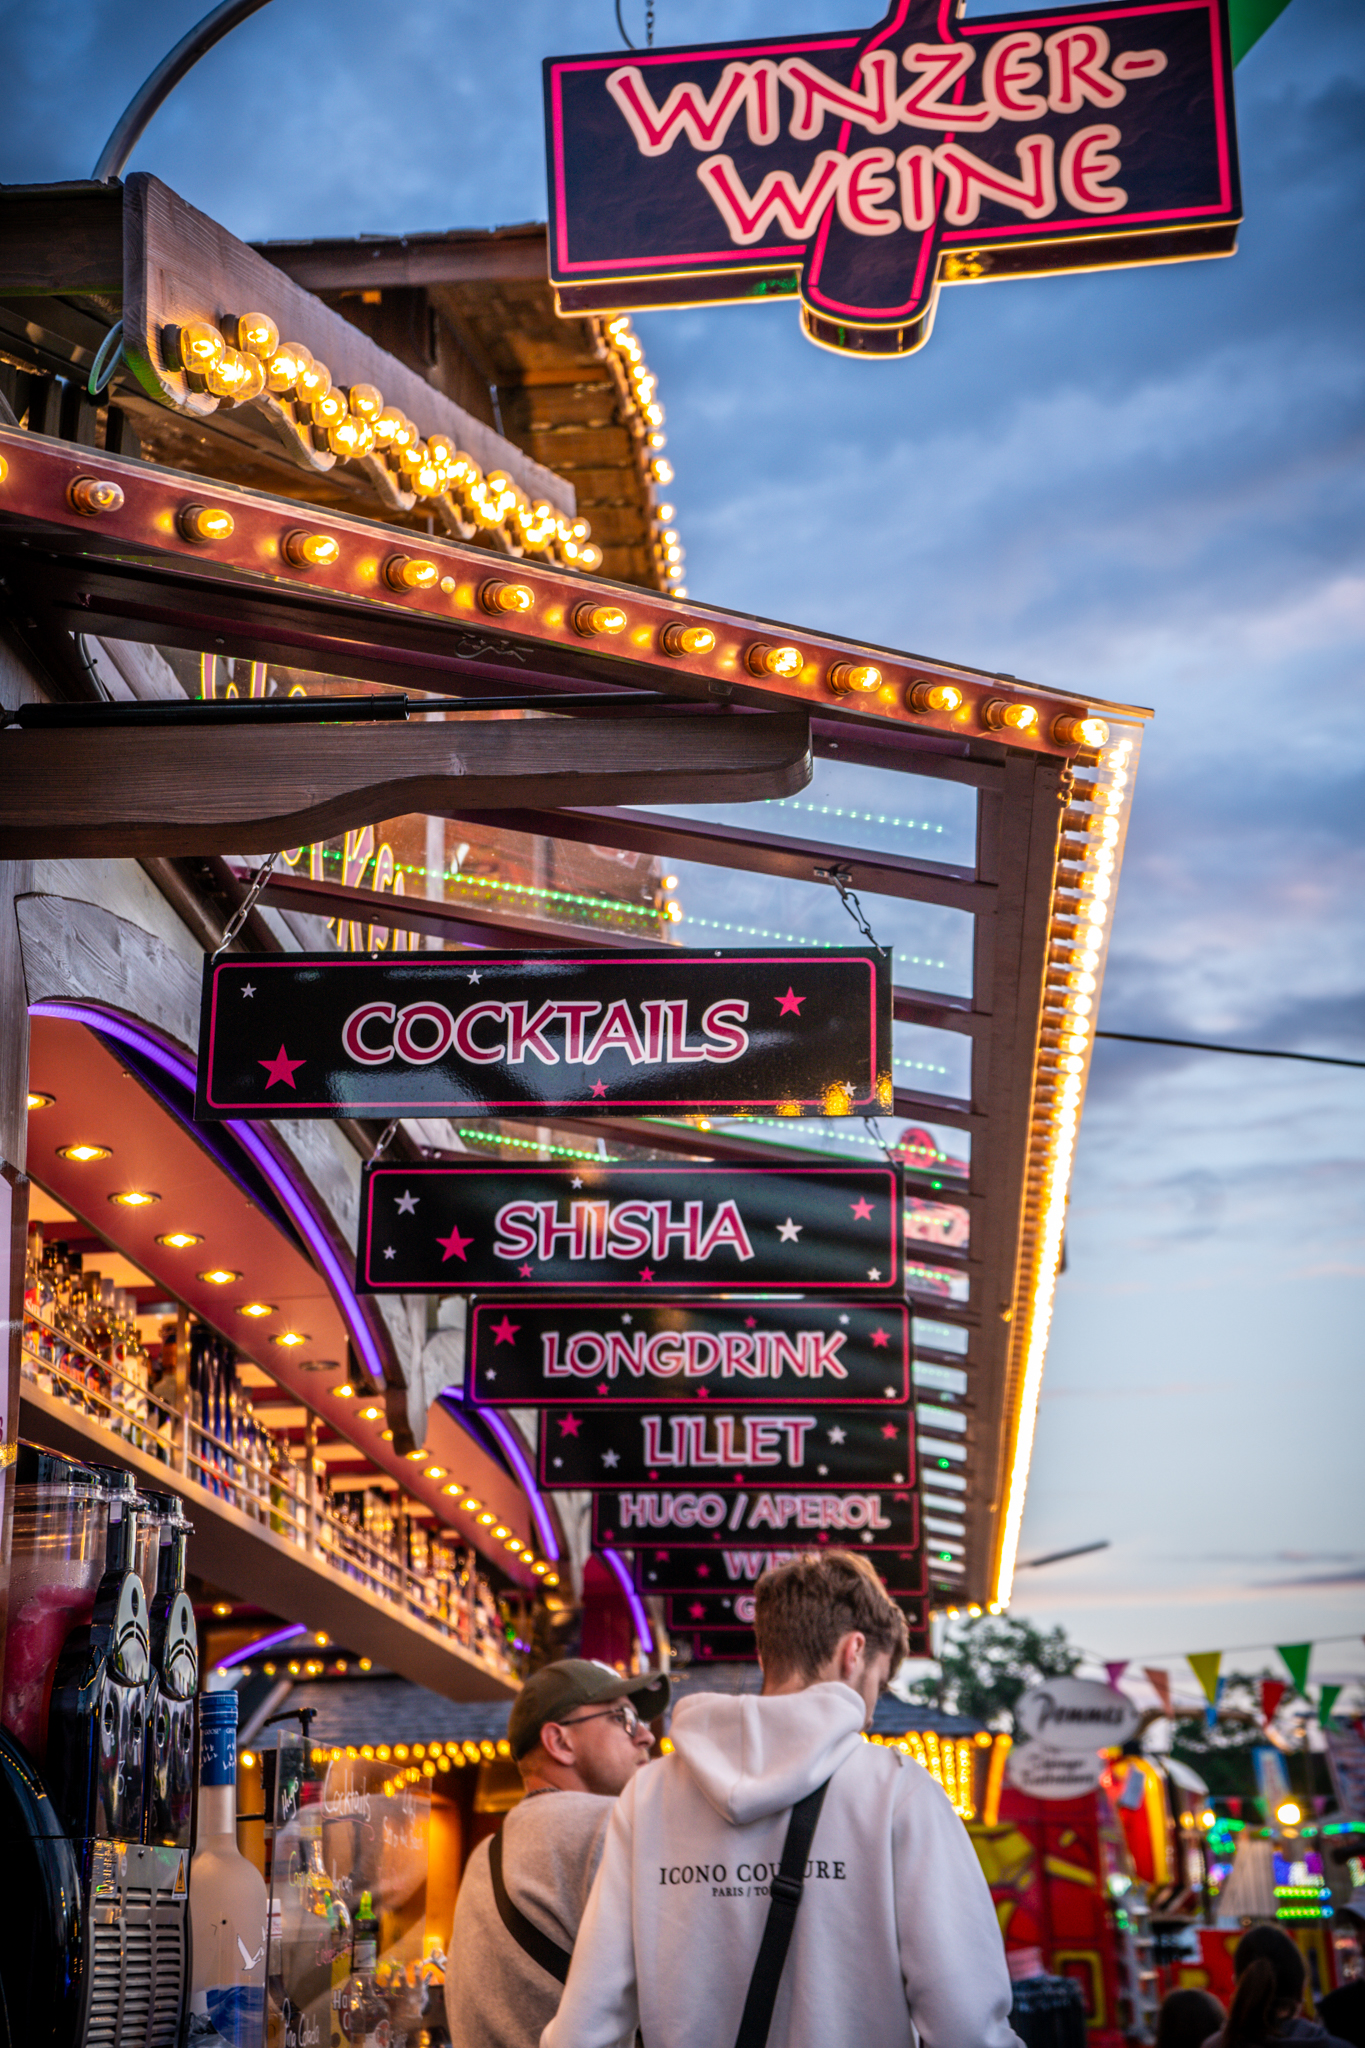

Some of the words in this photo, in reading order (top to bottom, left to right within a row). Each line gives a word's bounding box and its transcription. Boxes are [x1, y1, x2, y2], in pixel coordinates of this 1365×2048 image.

[606, 25, 1168, 156] WINZER-
[697, 124, 1128, 245] WEINE
[341, 998, 749, 1066] COCKTAILS
[493, 1199, 754, 1261] SHISHA
[541, 1331, 848, 1379] LONGDRINK
[641, 1415, 816, 1467] LILLET
[618, 1494, 725, 1529] HUGO
[748, 1495, 890, 1530] APEROL
[323, 1760, 371, 1822] Cocktails
[659, 1864, 727, 1885] ICONO
[737, 1861, 846, 1882] COUURE
[712, 1887, 744, 1897] PARIS
